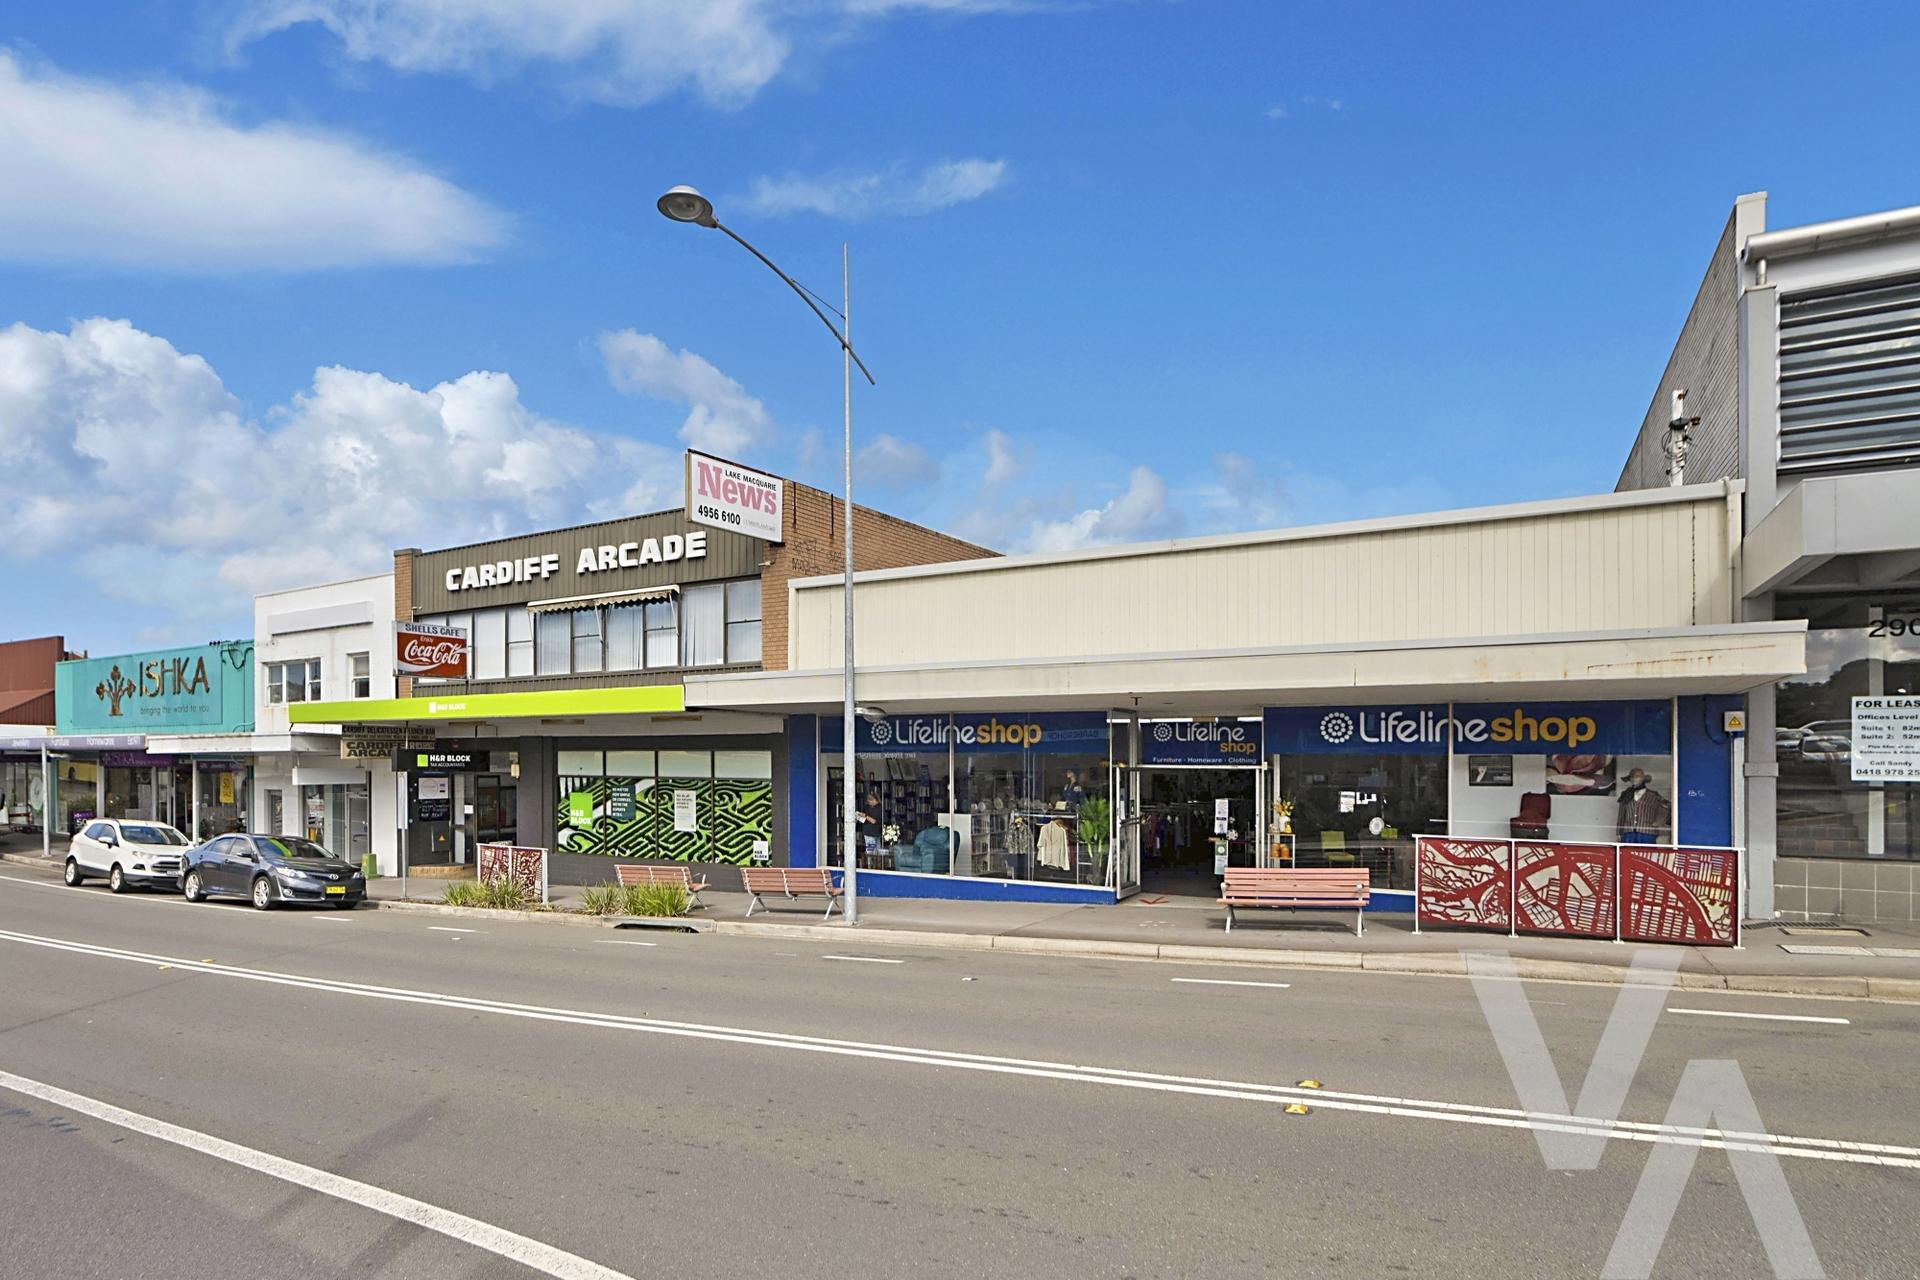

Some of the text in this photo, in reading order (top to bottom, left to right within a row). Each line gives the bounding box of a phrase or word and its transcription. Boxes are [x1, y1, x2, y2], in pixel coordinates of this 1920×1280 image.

[697, 461, 777, 515] News
[725, 469, 777, 492] LAKE MACQUARIE
[698, 504, 741, 526] 4956 6100
[445, 530, 707, 592] CARDIFF ARCADE
[405, 623, 460, 637] SHELLS CAFE
[404, 639, 462, 665] Coca-Cola
[139, 656, 210, 697] ISHKA
[140, 706, 160, 716] bringing
[174, 705, 188, 713] world
[199, 705, 209, 713] you
[1855, 700, 1882, 708] FOR
[895, 718, 1042, 749] Lifeline shop
[1175, 721, 1245, 742] Lifeline
[1359, 708, 1597, 748] Lifeline shop
[447, 754, 471, 762] BLOCK
[1220, 741, 1256, 755] shop
[1228, 756, 1257, 764] Clothing
[571, 808, 584, 816] H&R
[571, 817, 592, 825] BLOCK
